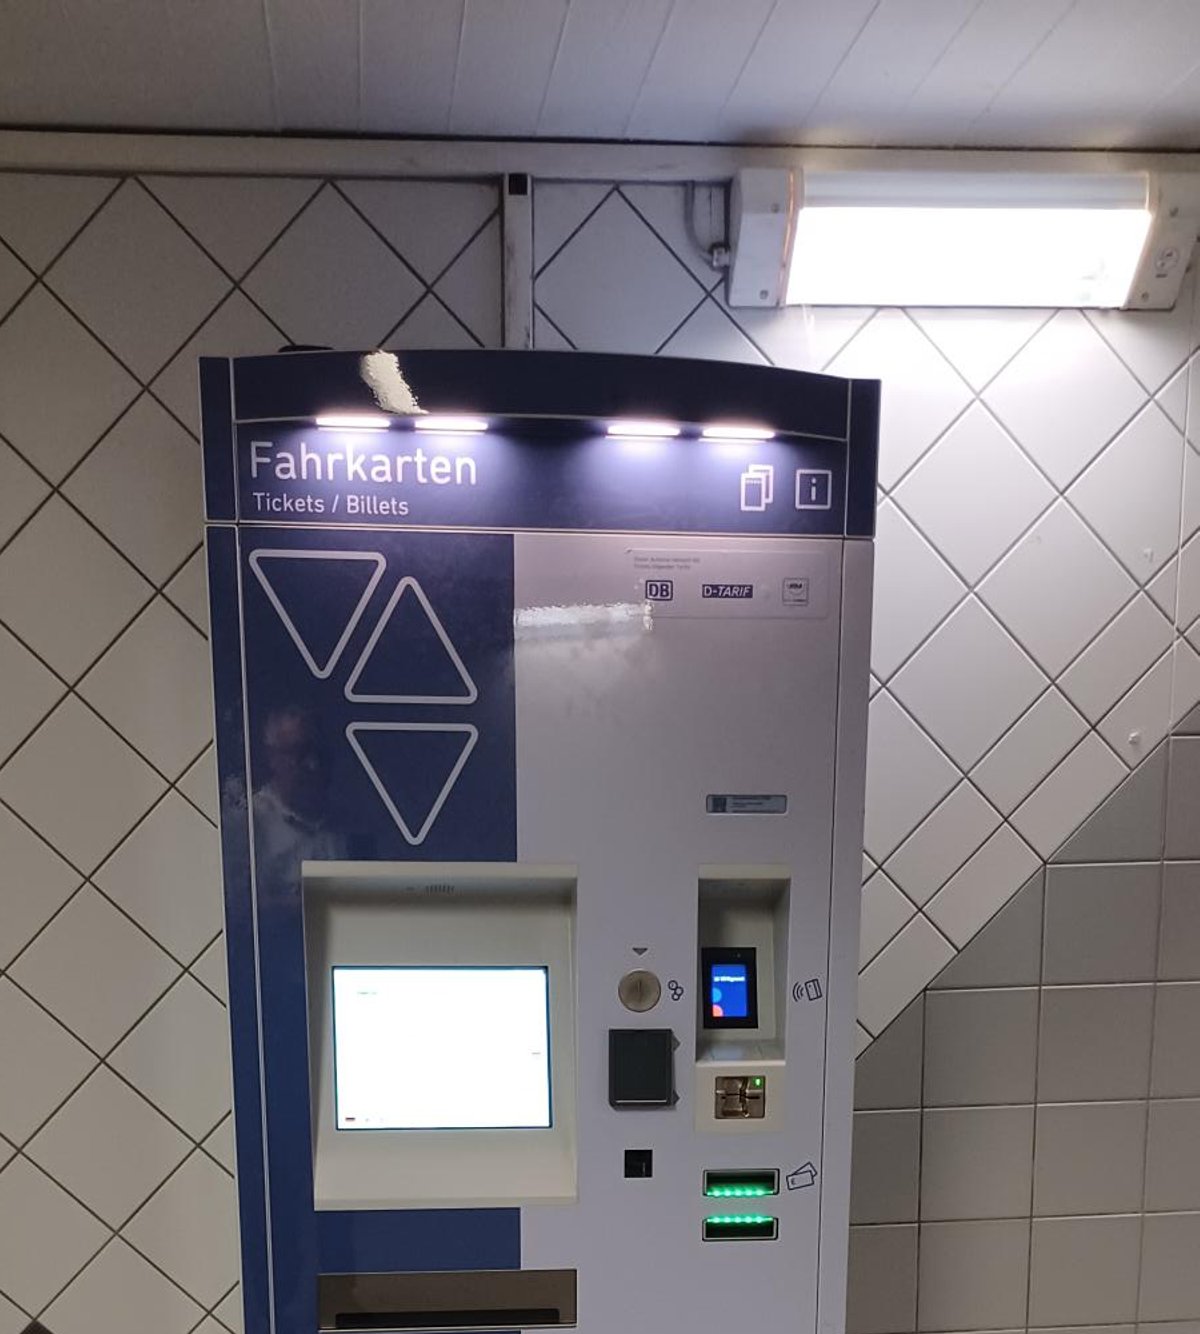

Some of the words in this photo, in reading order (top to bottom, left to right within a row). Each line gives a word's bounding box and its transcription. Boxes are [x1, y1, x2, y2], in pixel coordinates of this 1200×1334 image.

[250, 441, 477, 485] Fahrkarten
[253, 492, 325, 512] Tickets
[346, 495, 409, 515] Billets
[648, 583, 671, 598] DB
[703, 585, 752, 597] D-TARIF
